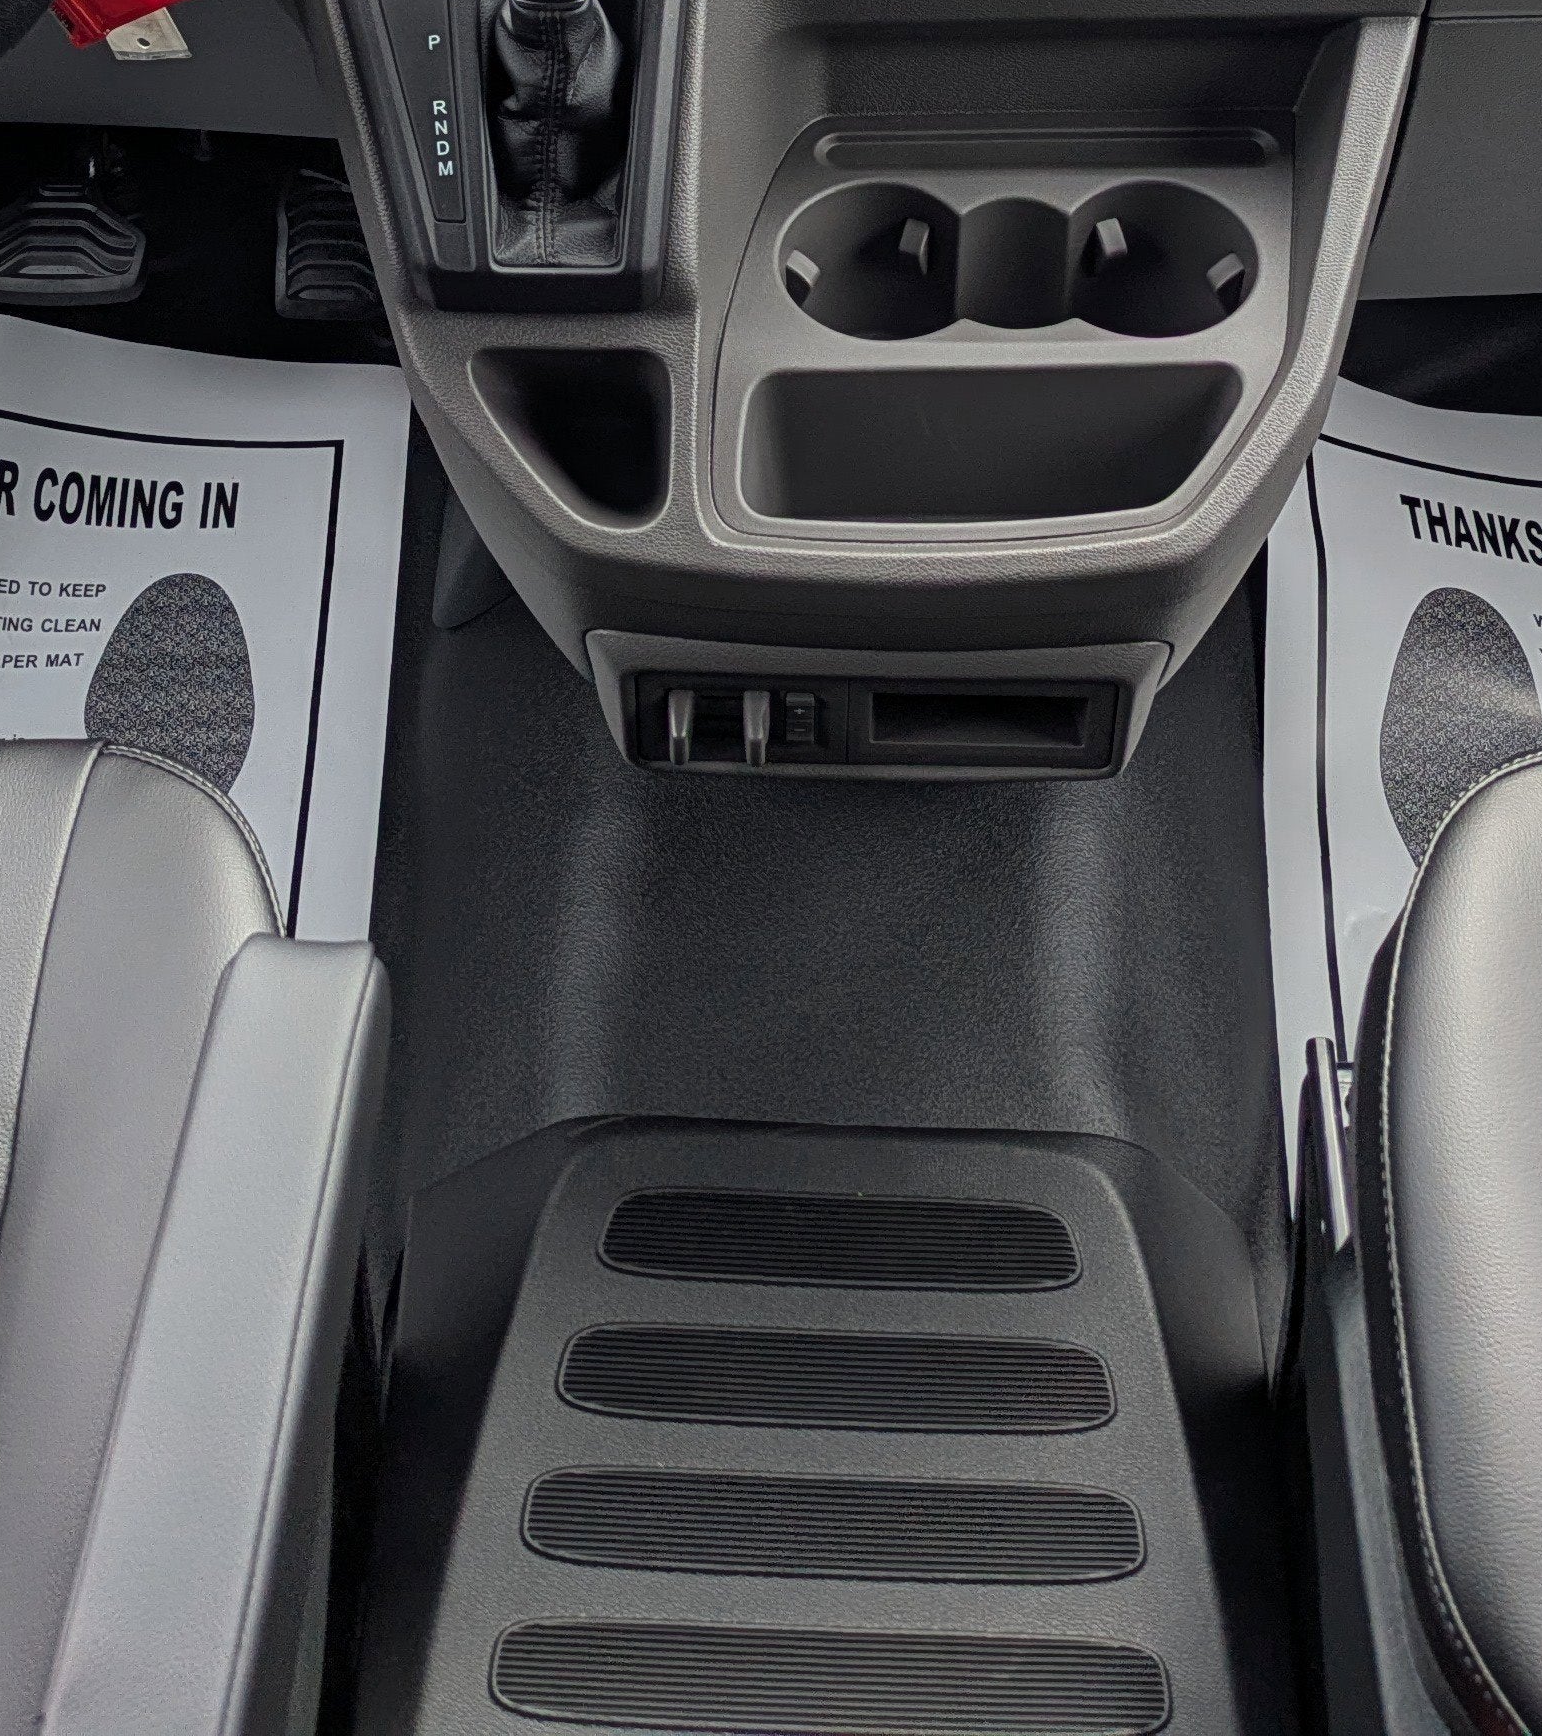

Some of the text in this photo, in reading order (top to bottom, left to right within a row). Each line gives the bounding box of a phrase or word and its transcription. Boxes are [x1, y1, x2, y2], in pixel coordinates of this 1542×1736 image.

[428, 34, 441, 51] P
[433, 100, 448, 115] R
[435, 120, 449, 135] N
[437, 141, 449, 156] D
[438, 160, 454, 176] M
[33, 465, 184, 531] COMING
[200, 480, 240, 530] IN
[27, 580, 54, 597] TO
[58, 581, 107, 599] KEEP
[40, 615, 103, 634] CLEAN
[44, 650, 85, 670] MAT
